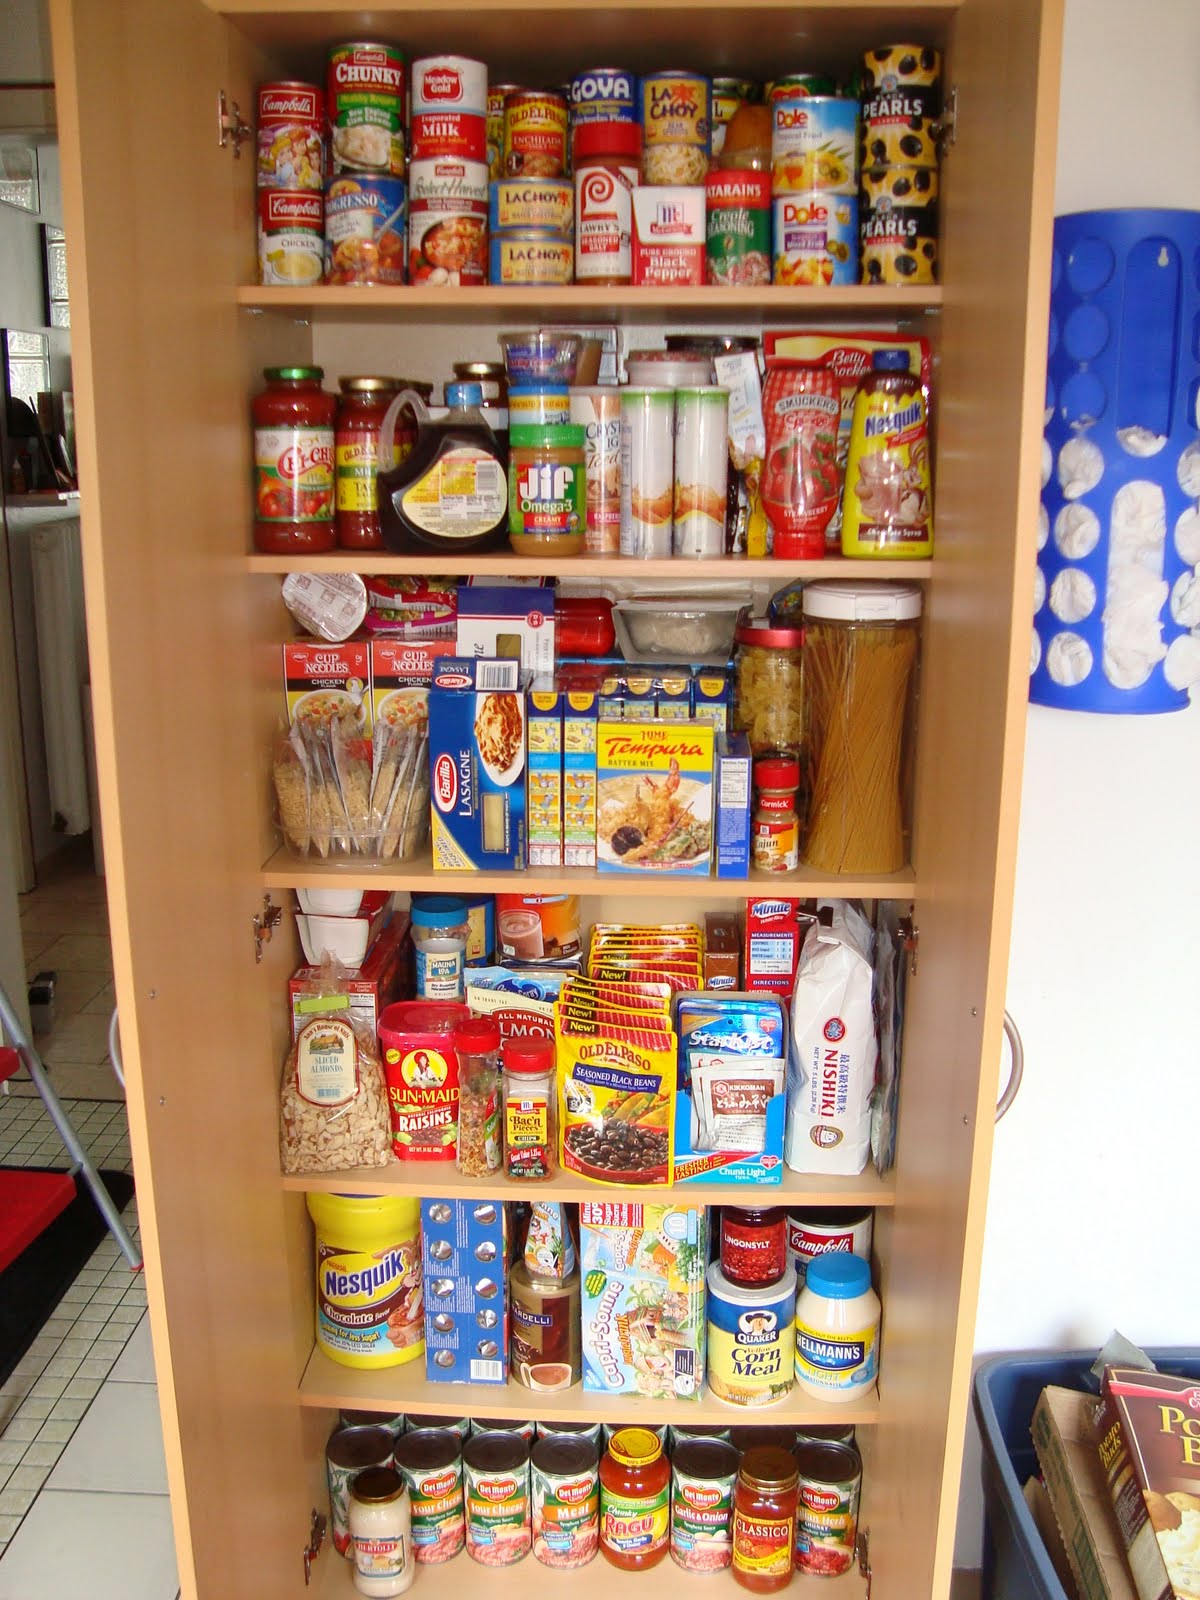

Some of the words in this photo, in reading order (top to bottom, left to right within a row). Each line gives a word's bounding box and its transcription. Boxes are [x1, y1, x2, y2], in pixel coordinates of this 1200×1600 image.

[336, 63, 402, 86] CHUNKY
[425, 74, 458, 84] Meadow
[431, 84, 451, 94] Gold
[572, 77, 630, 102] GOYA
[651, 86, 672, 102] LA
[262, 92, 312, 113] Campbell's
[863, 99, 922, 118] PEARLS
[421, 114, 461, 122] Evaporated
[650, 103, 698, 120] CHOY
[777, 108, 808, 128] Dole
[422, 124, 459, 136] Milk
[513, 135, 562, 145] ENCHILADA
[506, 192, 521, 203] LA
[522, 190, 559, 203] CHOY
[706, 183, 761, 198] ATARAIN'S
[711, 209, 750, 222] Creole
[784, 201, 828, 224] Dole
[861, 219, 917, 237] PEARLS
[281, 239, 315, 248] CHICKEN
[509, 249, 525, 261] LA
[527, 247, 561, 260] CHOY
[650, 256, 687, 267] Black
[645, 267, 692, 280] Pepper
[831, 350, 867, 364] Betty
[865, 402, 922, 437] Nesquik
[520, 463, 574, 500] Jif
[315, 653, 340, 664] CUP
[403, 651, 428, 661] CUP
[305, 662, 349, 674] NOODLES
[605, 737, 704, 760] Tempura
[440, 761, 452, 799] Barilla
[459, 749, 472, 817] LASAGNE
[752, 903, 791, 915] Minute
[431, 960, 456, 971] MAUNA
[600, 970, 626, 980] New!
[708, 977, 736, 985] Minute
[567, 1007, 593, 1018] New!
[516, 1014, 554, 1027] NATURAL
[570, 1021, 595, 1032] New!
[688, 1031, 774, 1051] StarKist
[314, 1056, 339, 1064] SLICED
[579, 1043, 604, 1060] OLD
[605, 1041, 621, 1053] EL
[621, 1044, 651, 1071] PASO
[310, 1065, 344, 1073] ALMONDS
[575, 1066, 611, 1081] SEASONED
[611, 1073, 633, 1087] BLACK
[633, 1078, 657, 1088] BEANS
[821, 1049, 838, 1117] NISHIKI
[399, 1110, 453, 1132] RAISINS
[509, 1116, 544, 1128] Bac'n
[513, 1124, 539, 1132] Pieces
[675, 1157, 709, 1174] FRESHER
[675, 1162, 713, 1180] TASTING!
[719, 1167, 745, 1176] Chunk
[746, 1168, 766, 1177] Light
[724, 1234, 770, 1249] LINGONSYLT
[791, 1231, 851, 1255] Campbell's
[325, 1250, 404, 1298] Nesquik
[324, 1303, 374, 1325] Chocolate
[374, 1308, 391, 1322] flavor
[588, 1279, 625, 1388] Capri-Sonne
[737, 1331, 777, 1344] QUAKER
[796, 1335, 860, 1360] HELLMANN'S
[732, 1348, 780, 1363] Corn
[732, 1359, 781, 1377] Meal
[807, 1368, 841, 1381] LIGHT
[1098, 1421, 1120, 1453] Potato
[1103, 1437, 1121, 1469] Buds
[423, 1484, 436, 1492] Del
[436, 1477, 456, 1490] Monte
[480, 1485, 492, 1494] Del
[492, 1485, 515, 1494] Monte
[558, 1490, 571, 1498] Del
[571, 1483, 592, 1496] Monte
[684, 1490, 697, 1499] Del
[698, 1493, 719, 1501] Monte
[803, 1492, 813, 1502] Del
[813, 1495, 837, 1506] Monte
[471, 1503, 492, 1515] Four
[492, 1501, 524, 1515] Cheese
[557, 1502, 589, 1519] Meat
[607, 1505, 638, 1519] Chunky
[675, 1505, 696, 1520] Garlic
[702, 1512, 728, 1522] Onion
[736, 1518, 788, 1537] CLASSICO
[804, 1521, 829, 1531] CHUNKY
